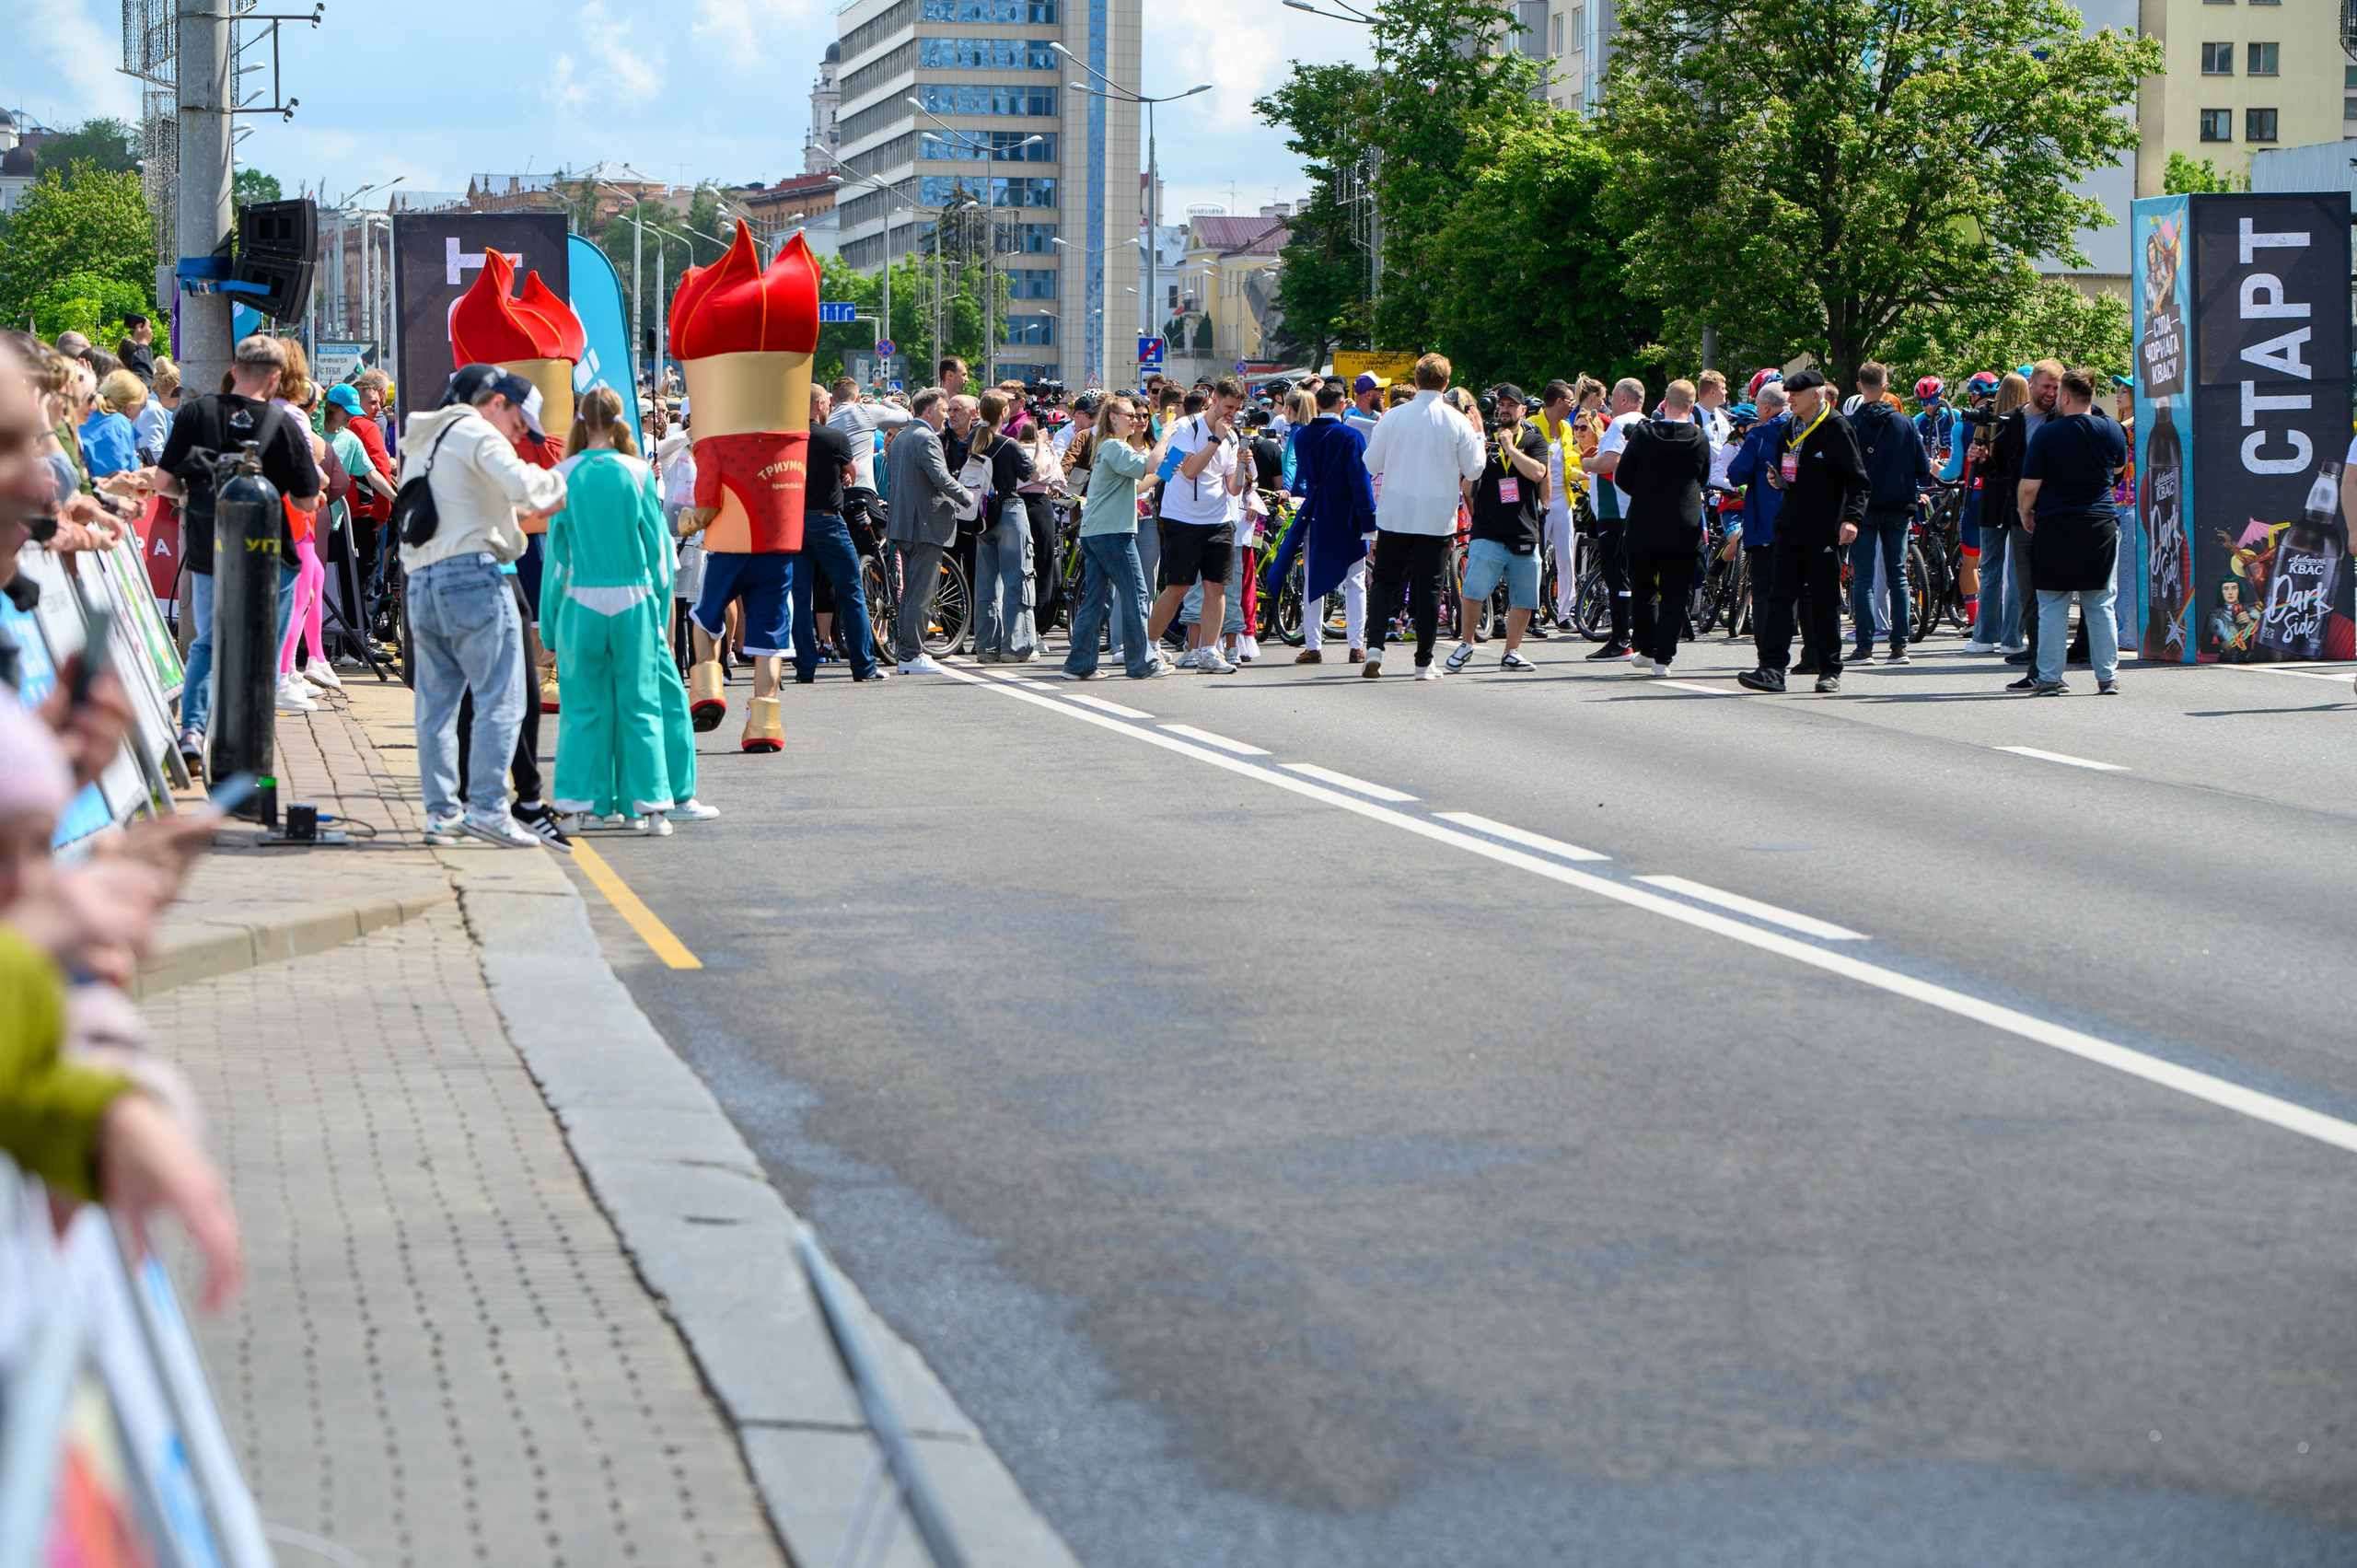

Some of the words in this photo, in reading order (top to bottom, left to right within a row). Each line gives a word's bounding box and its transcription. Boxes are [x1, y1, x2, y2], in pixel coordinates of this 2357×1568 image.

[2145, 332, 2180, 364] ЧОРНАГА
[2239, 217, 2313, 475] СТАРТ
[325, 366, 341, 375] ТЕБЯ
[2152, 357, 2177, 386] КВАСУ
[2149, 504, 2183, 575] Dark
[2161, 552, 2180, 598] Side
[2288, 563, 2324, 575] КВАС
[2267, 575, 2333, 623] Dark
[2282, 611, 2319, 644] Side
